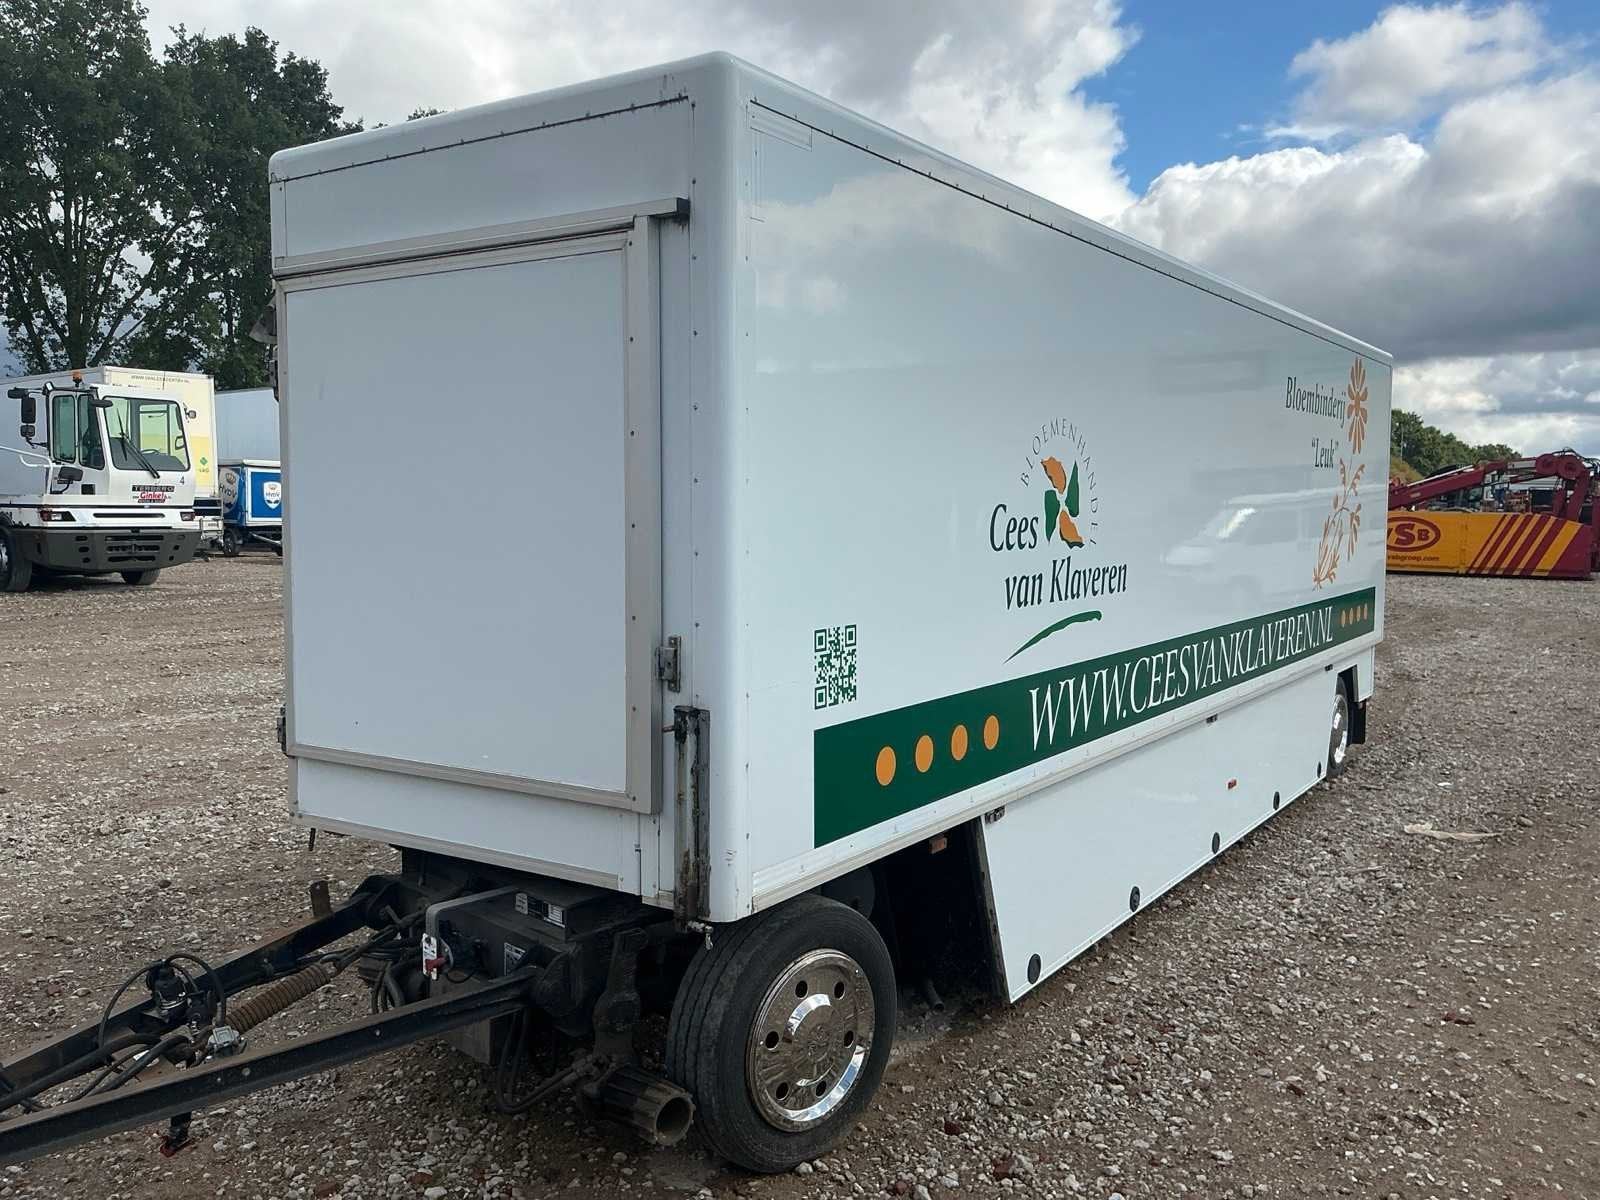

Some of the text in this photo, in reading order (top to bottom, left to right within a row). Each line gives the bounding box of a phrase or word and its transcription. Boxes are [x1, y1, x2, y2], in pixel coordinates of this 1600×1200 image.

[1286, 376, 1346, 428] Bloembinderij
[140, 491, 164, 499] Ginkel
[989, 503, 1039, 552] Cees
[1004, 556, 1128, 610] van Klaveren
[1028, 605, 1335, 752] WWW.CEESVANKLAVEREN.NL
